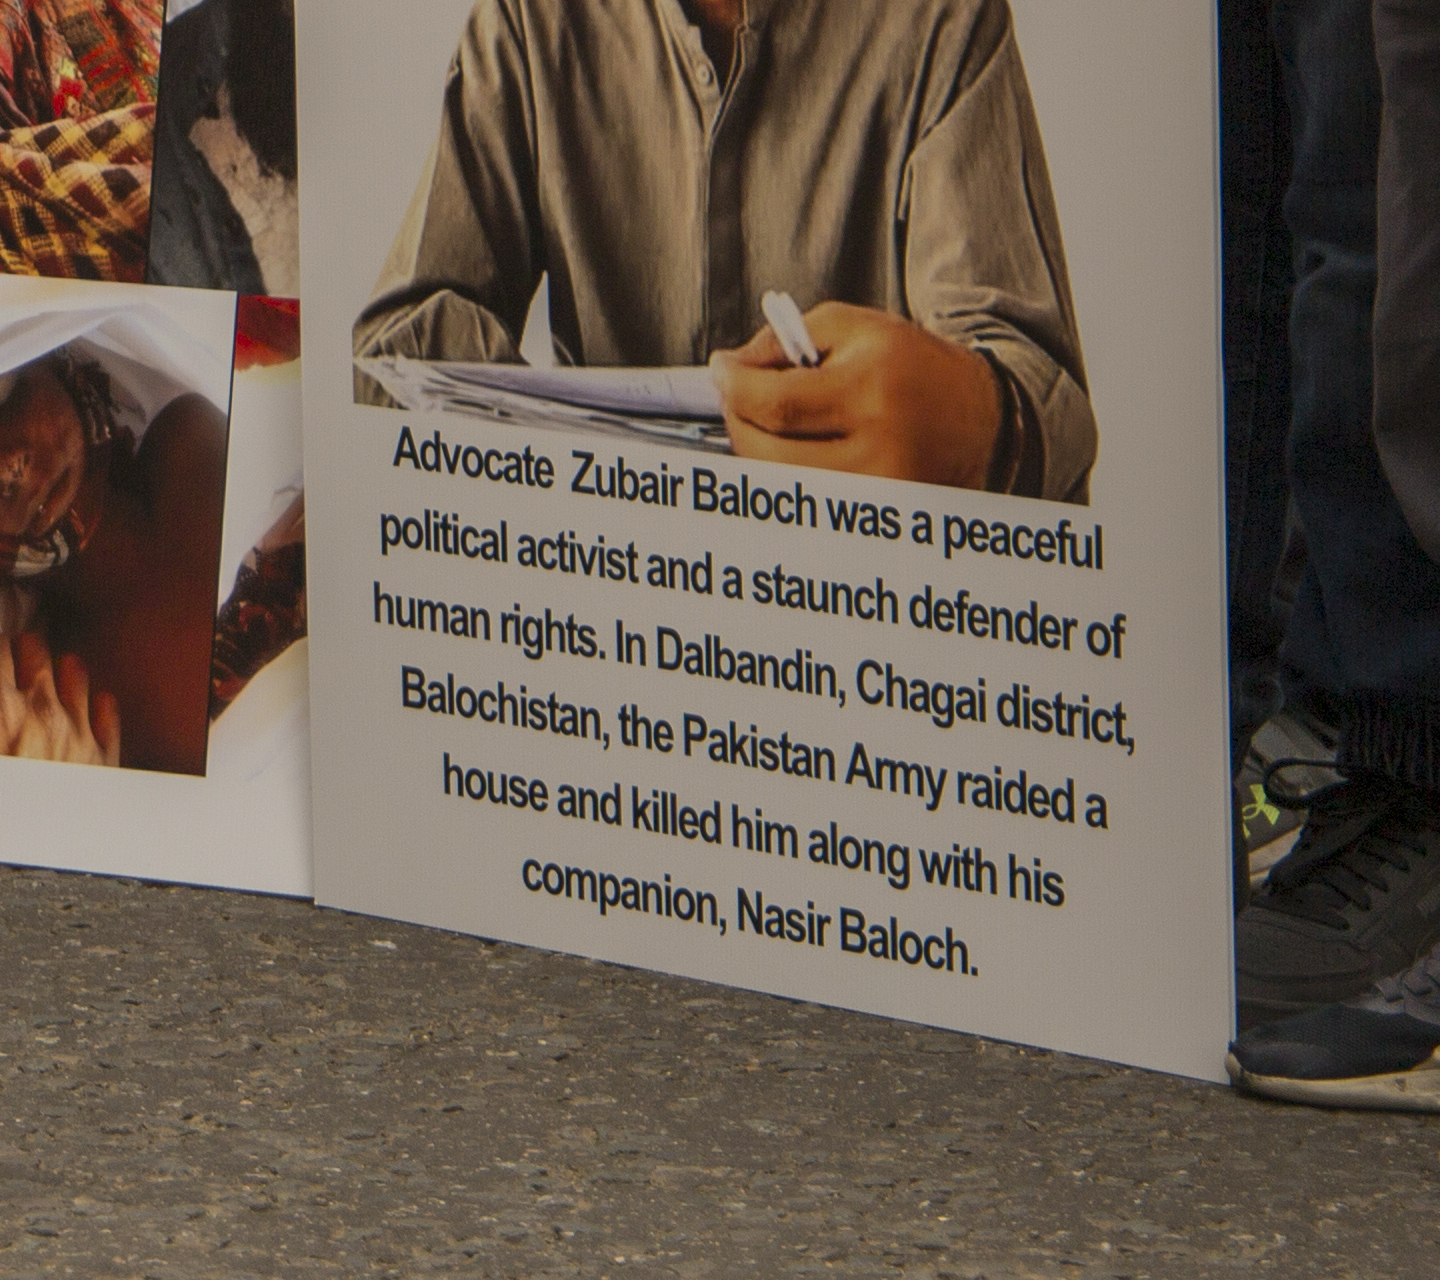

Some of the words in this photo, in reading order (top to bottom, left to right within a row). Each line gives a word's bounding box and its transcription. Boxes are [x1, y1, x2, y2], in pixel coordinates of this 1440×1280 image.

[392, 425, 555, 489] Advocate
[570, 450, 684, 508] Zubair
[692, 466, 817, 528] Baloch
[825, 496, 902, 540] was
[910, 510, 934, 546] a
[942, 513, 1104, 570] peaceful
[380, 508, 508, 563] political
[517, 519, 640, 584] activist
[647, 551, 713, 595] and
[721, 564, 743, 600] a
[752, 563, 899, 624] staunch
[909, 584, 1077, 651] defender
[1086, 612, 1126, 659] of
[373, 580, 491, 641] human
[500, 603, 607, 660] rights.
[616, 618, 647, 667] In
[656, 625, 846, 708] Dalbandin,
[855, 658, 987, 729] Chagai
[996, 682, 1135, 756] district,
[400, 664, 610, 751] Balochistan,
[618, 704, 674, 753] the
[682, 712, 837, 782] Pakistan
[844, 742, 948, 811] Army
[957, 765, 1075, 824] raided
[1084, 792, 1109, 830] a
[442, 752, 548, 812] house
[557, 782, 622, 826] and
[631, 785, 722, 845] killed
[730, 803, 799, 859] him
[808, 821, 910, 890] along
[919, 843, 998, 895] with
[1008, 854, 1066, 907] his
[521, 858, 727, 936] companion,
[737, 887, 832, 947] Nasir
[839, 906, 979, 977] Baloch.
